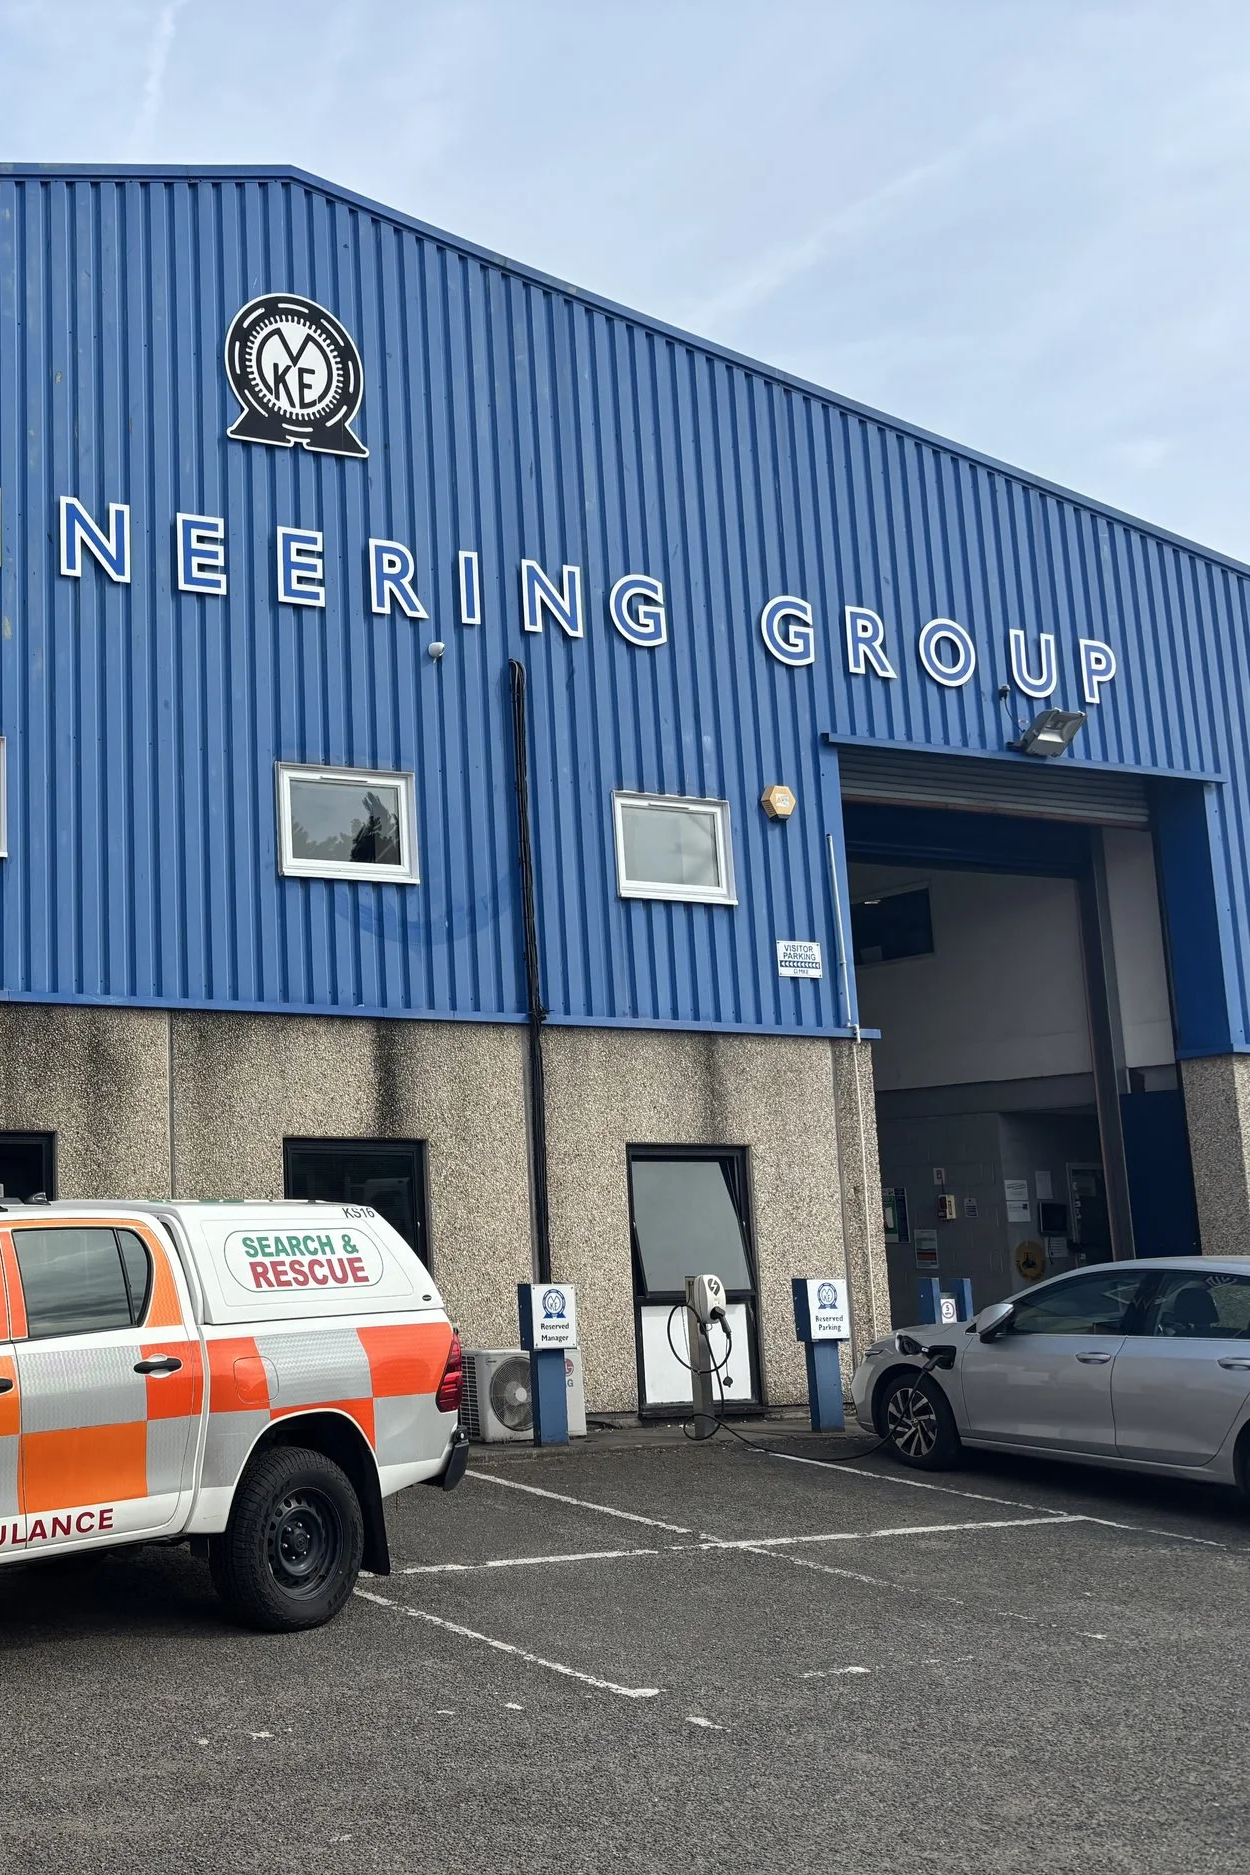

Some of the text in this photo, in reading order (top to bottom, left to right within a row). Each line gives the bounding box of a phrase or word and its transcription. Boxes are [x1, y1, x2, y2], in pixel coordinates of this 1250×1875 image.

[760, 594, 1117, 705] GROUP
[783, 944, 814, 953] VISITOR
[782, 952, 817, 961] PARKING
[342, 1206, 376, 1219] KS16
[242, 1233, 359, 1259] SEARCH &
[249, 1256, 370, 1289] RESCUE
[540, 1323, 570, 1331] Reserved
[818, 1324, 842, 1332] Parking
[541, 1334, 569, 1343] Manager
